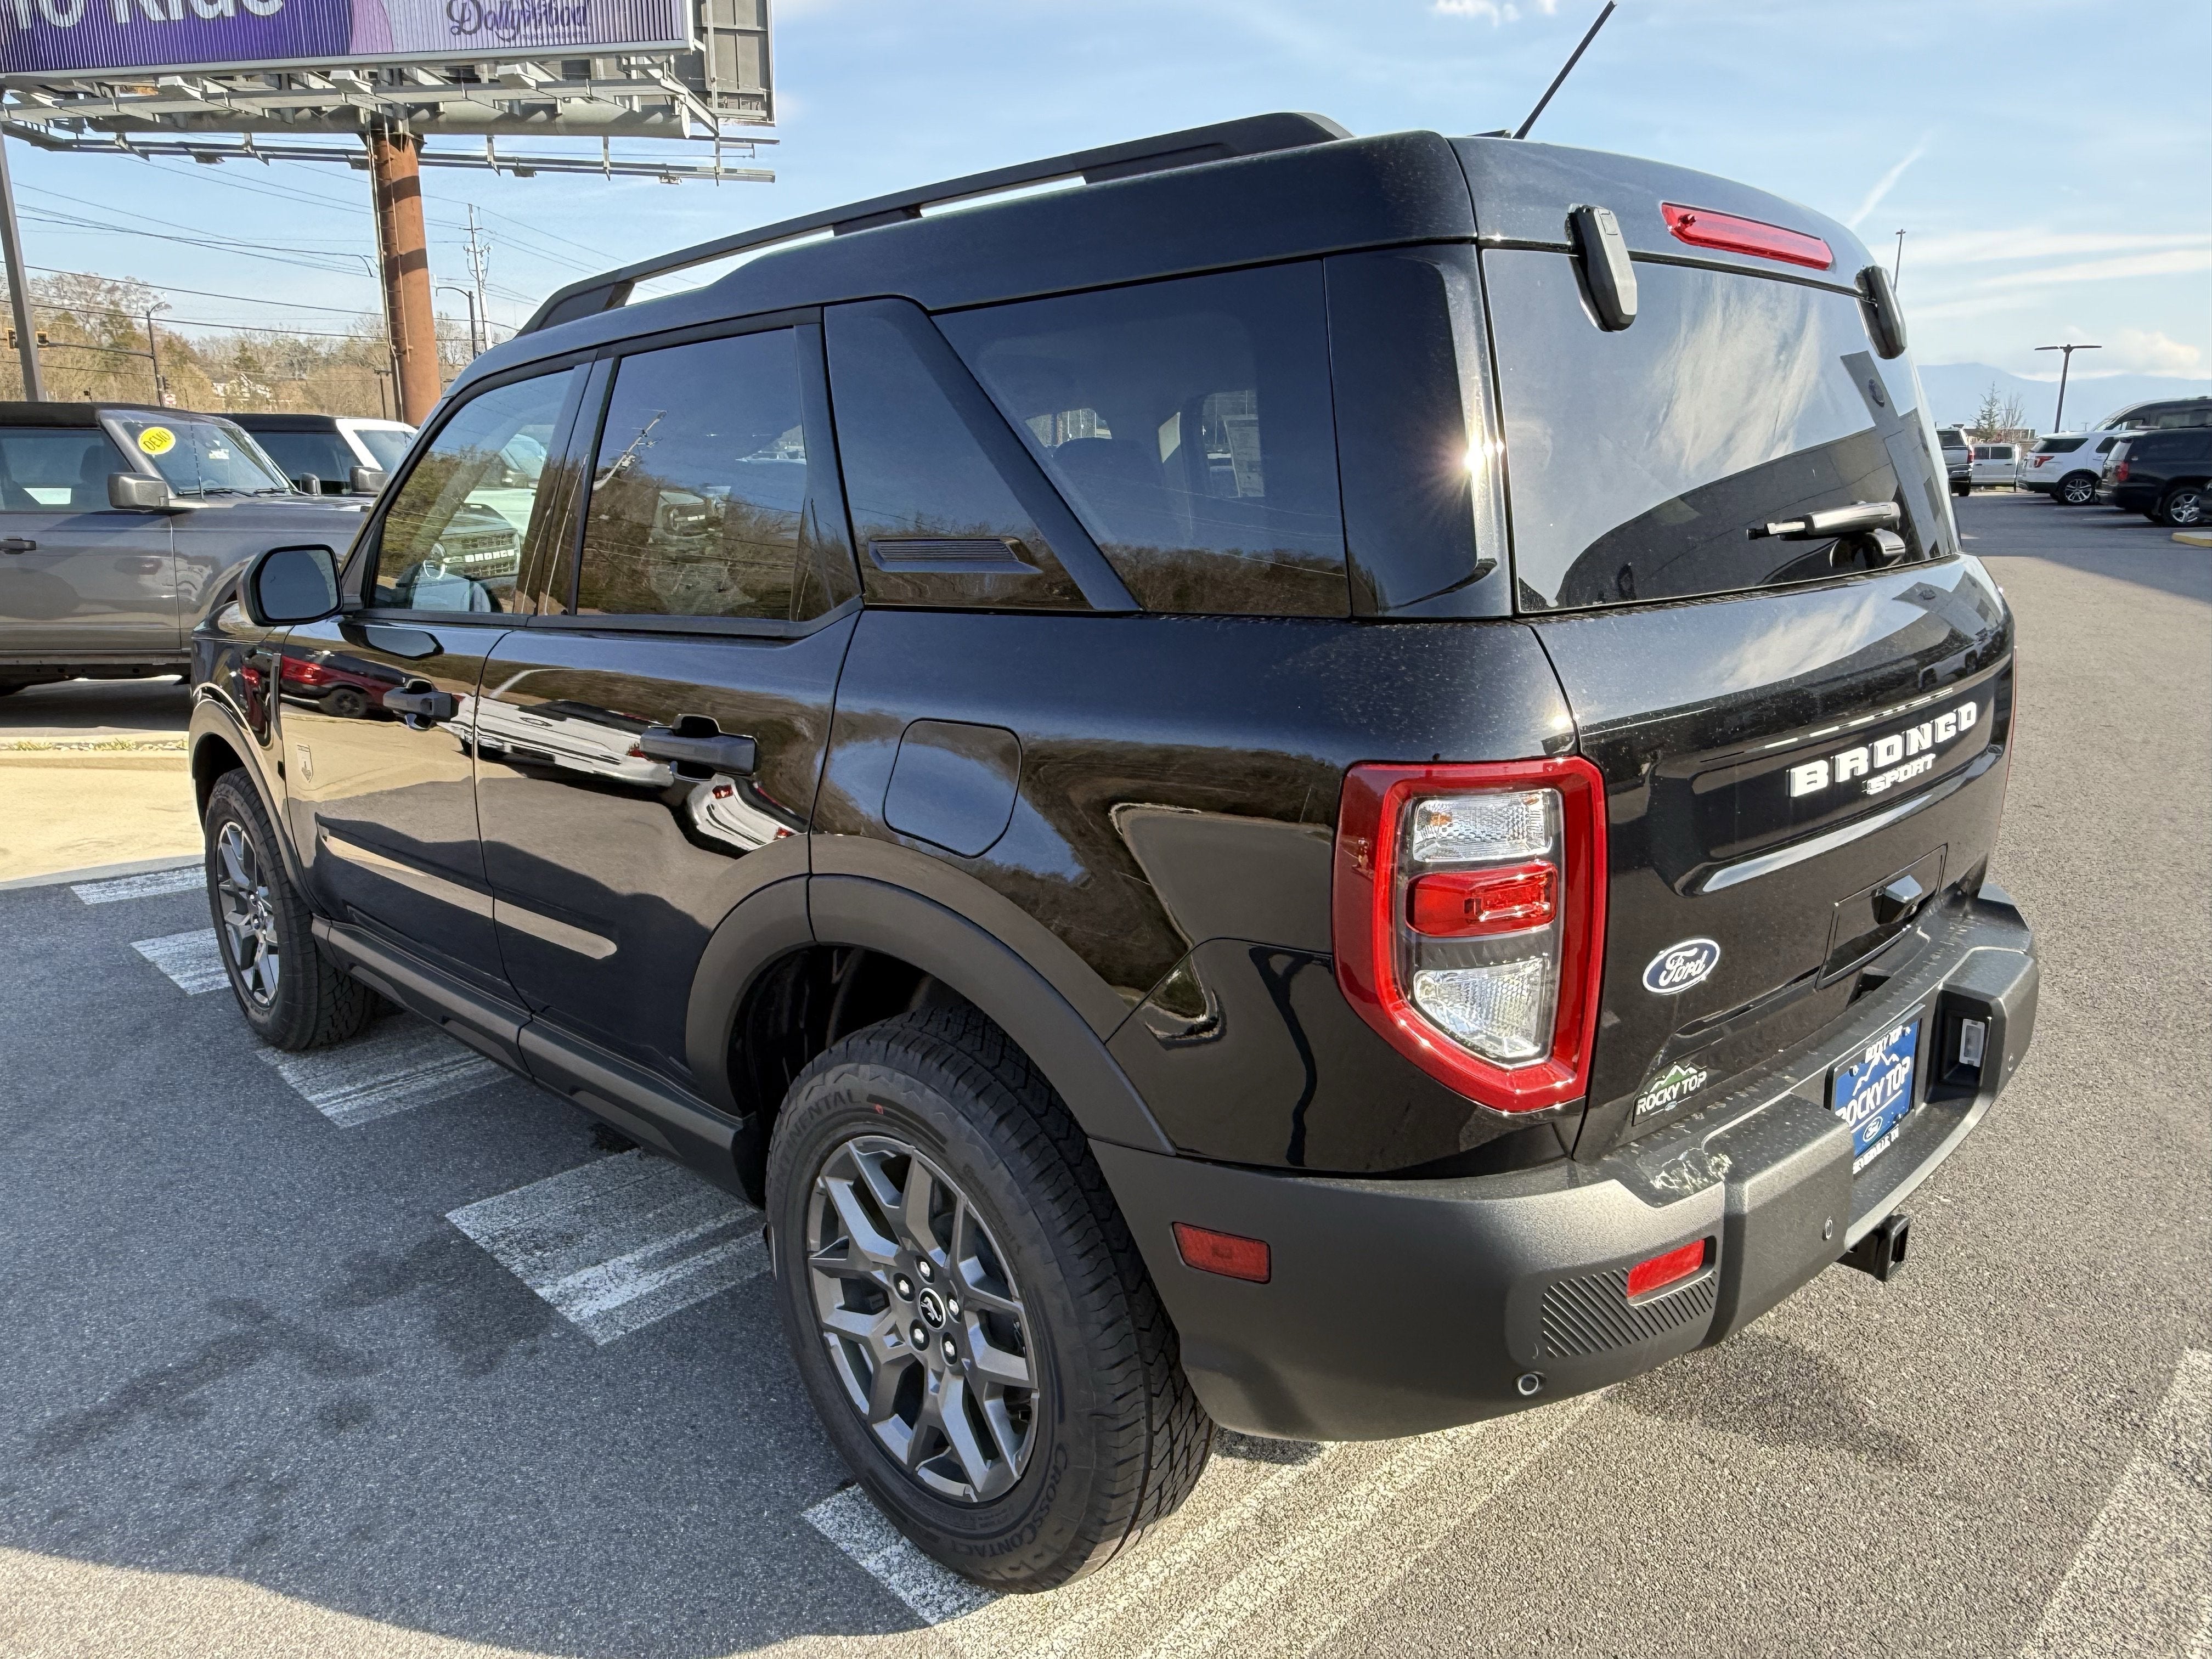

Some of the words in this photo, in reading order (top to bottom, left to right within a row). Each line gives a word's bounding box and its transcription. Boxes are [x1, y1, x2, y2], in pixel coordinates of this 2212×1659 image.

[1787, 701, 1977, 798] BRONCO
[1863, 753, 1936, 795] SPORT
[1658, 947, 1709, 986] Ford
[1637, 1080, 1682, 1115] ROCKY
[1681, 1071, 1707, 1094] TOP
[1886, 1056, 1911, 1097] TOP
